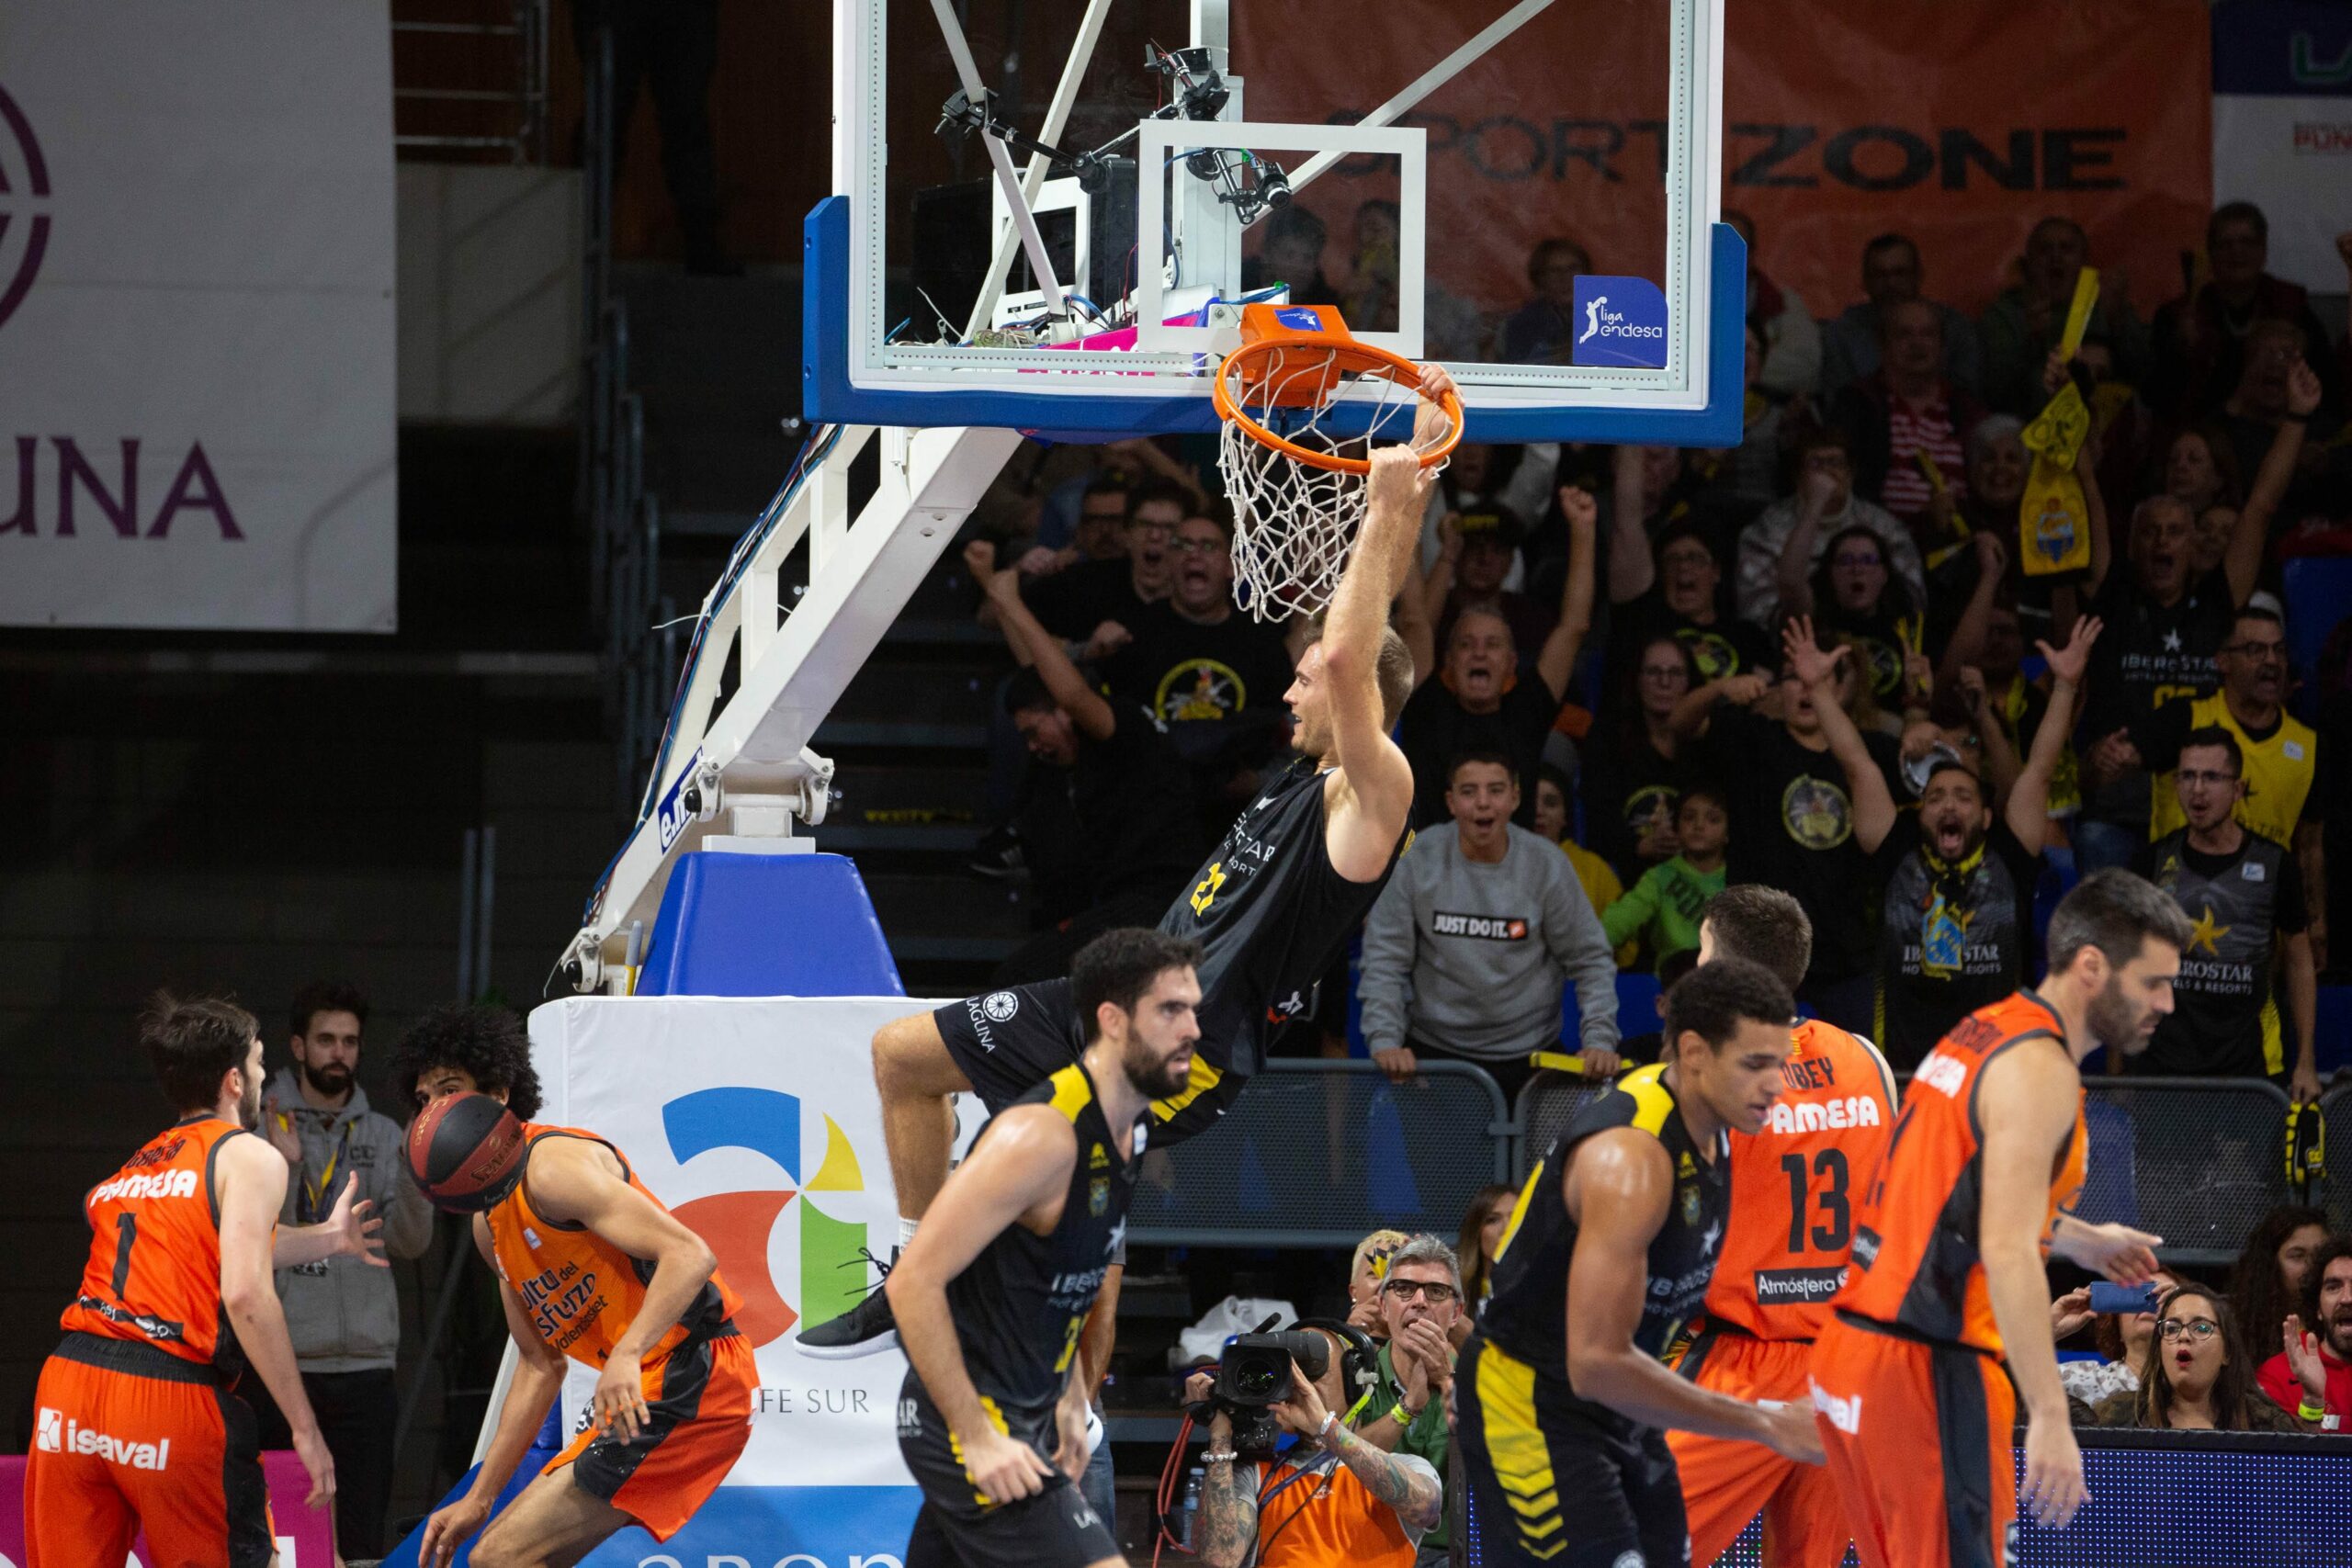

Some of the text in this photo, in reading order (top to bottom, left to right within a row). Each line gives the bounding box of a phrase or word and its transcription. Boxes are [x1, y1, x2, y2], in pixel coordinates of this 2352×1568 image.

[1731, 124, 2127, 191] ZONE
[1600, 304, 1623, 325] liga
[1600, 322, 1663, 338] endesa
[1434, 914, 1467, 935] JUST
[1467, 918, 1491, 937] DO
[966, 996, 997, 1055] LAGUNA
[89, 1168, 198, 1209] PAMESA
[1781, 1147, 1850, 1253] 13
[111, 1212, 139, 1301] 1
[558, 1260, 581, 1283] del
[1758, 1273, 1838, 1301] Atmósfera
[808, 1389, 870, 1413] SUR
[67, 1419, 170, 1472] isaval
